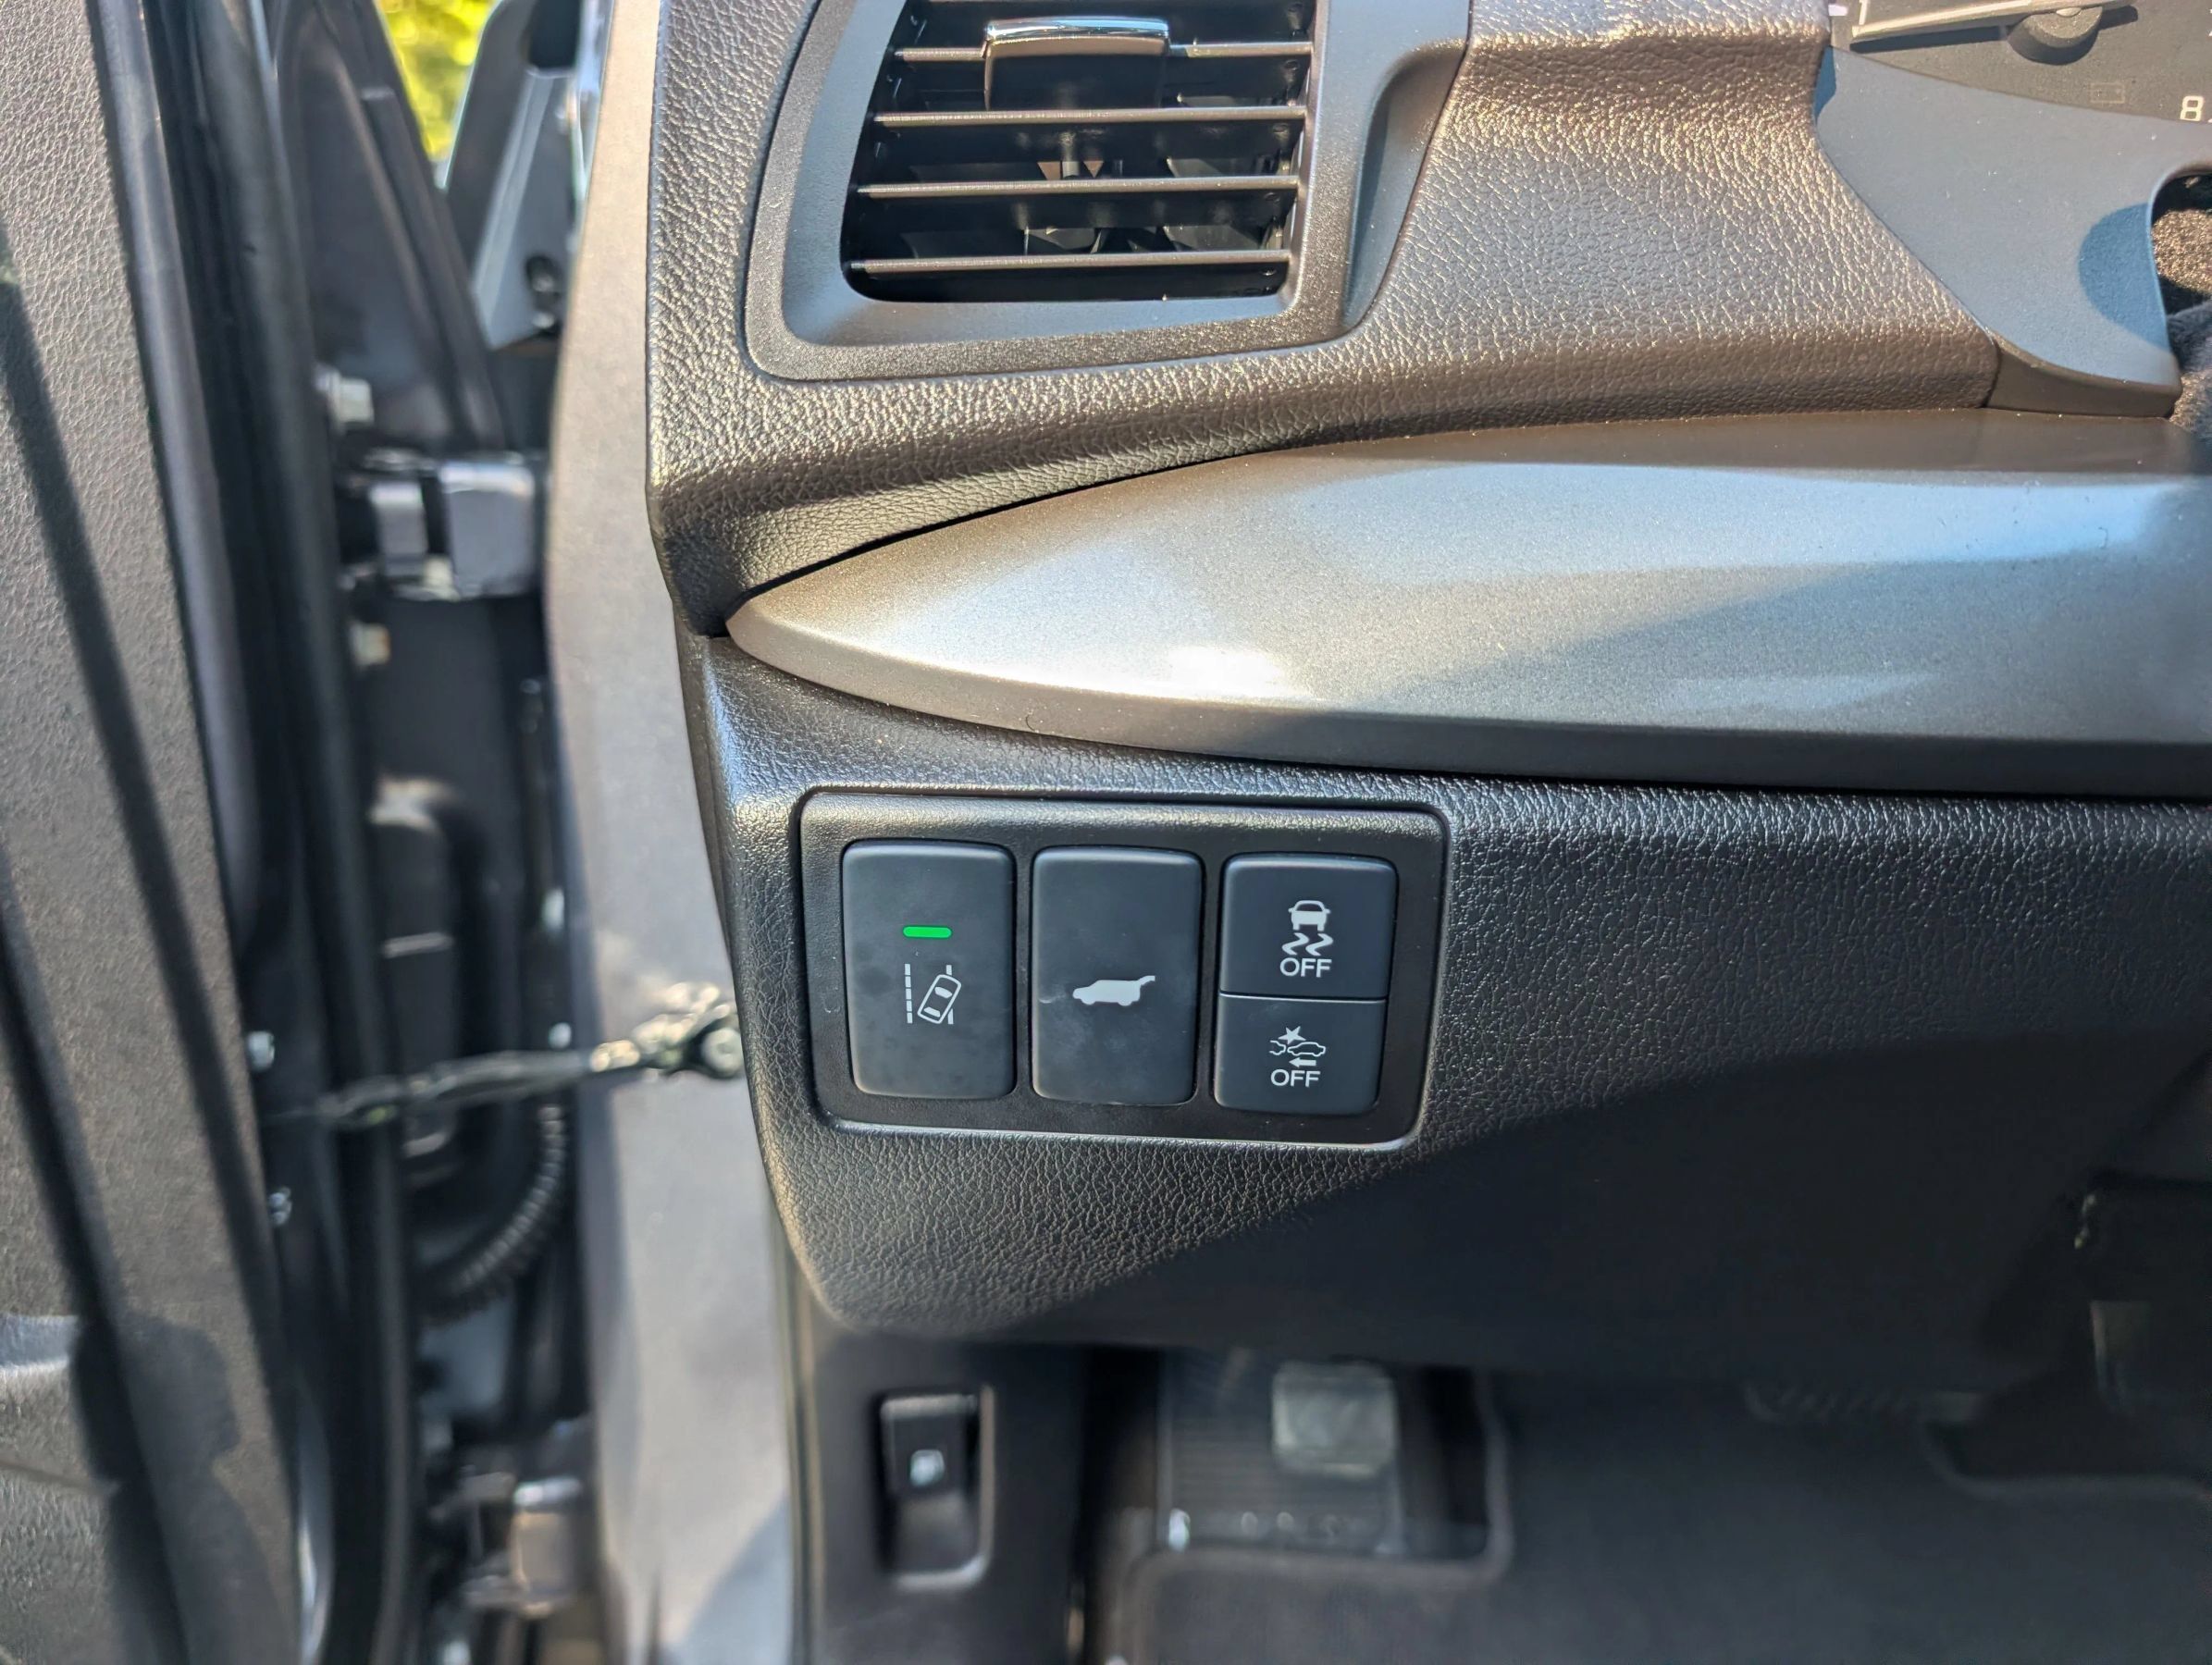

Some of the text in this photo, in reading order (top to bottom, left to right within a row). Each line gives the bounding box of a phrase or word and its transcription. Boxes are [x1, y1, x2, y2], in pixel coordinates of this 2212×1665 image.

[2180, 94, 2205, 122] 8
[1279, 956, 1332, 978] OFF
[1270, 1068, 1321, 1088] OFF
